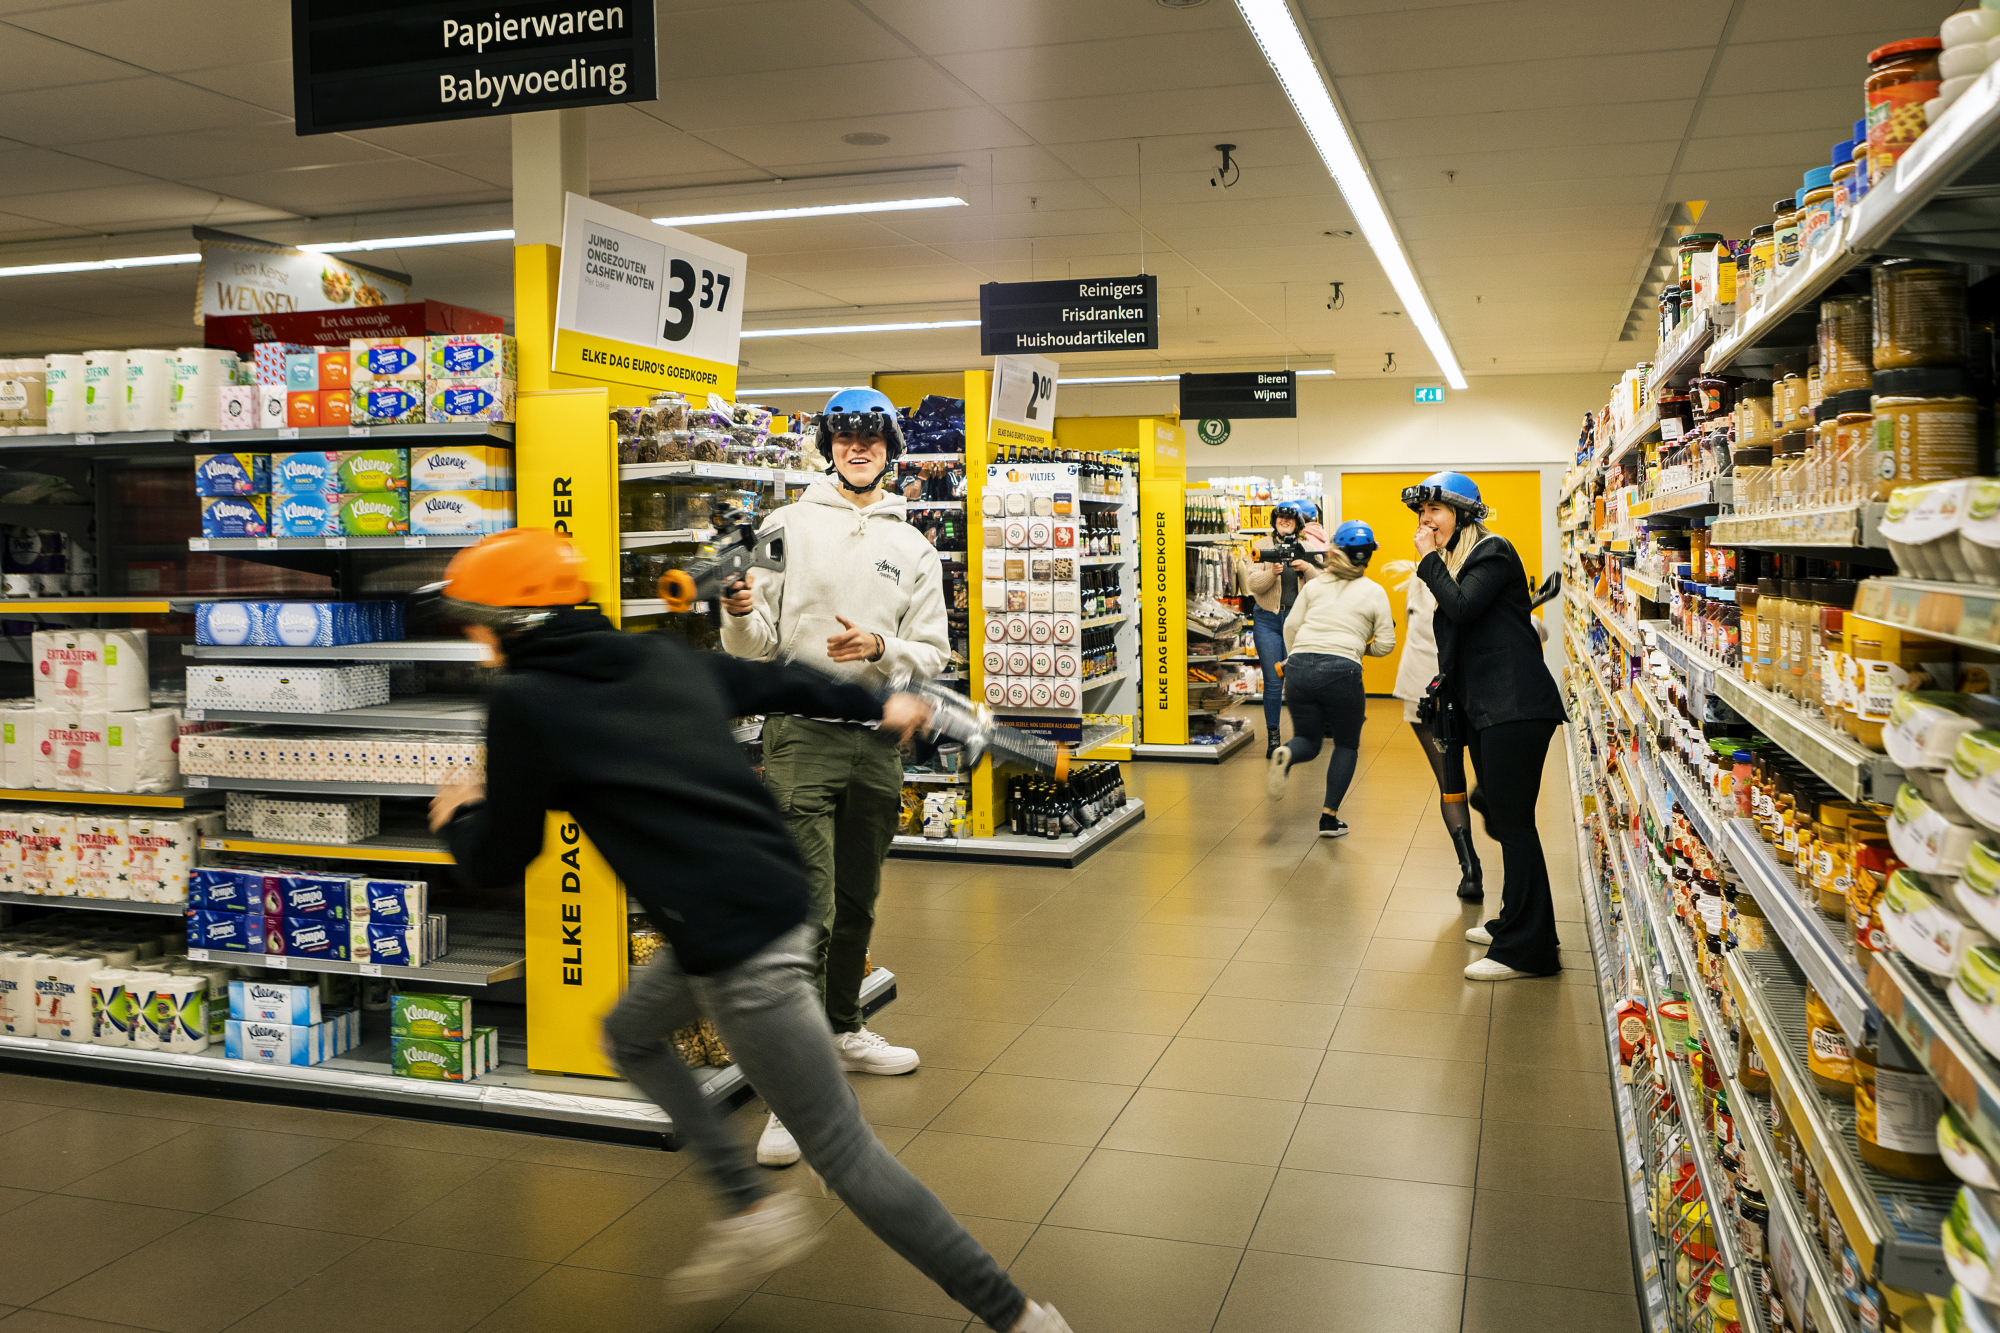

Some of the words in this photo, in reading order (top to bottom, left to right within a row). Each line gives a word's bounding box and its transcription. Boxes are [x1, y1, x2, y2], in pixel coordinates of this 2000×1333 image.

[443, 5, 624, 53] Papierwaren
[439, 59, 628, 106] Babyvoeding
[588, 234, 619, 252] JUMBO
[587, 248, 647, 275] ONGEZOUTEN
[234, 263, 257, 276] Een
[259, 262, 290, 286] Kerst
[586, 262, 625, 283] CASHEW
[626, 275, 655, 291] NOTEN
[217, 282, 299, 314] WENSEN
[663, 258, 697, 342] 3
[699, 269, 731, 313] 37
[1079, 282, 1144, 300] Reinigers
[318, 316, 338, 328] Zet
[340, 316, 354, 326] de
[355, 312, 391, 328] magie
[1062, 306, 1144, 323] Frisdranken
[314, 331, 336, 342] van
[338, 328, 362, 340] kerst
[364, 330, 380, 340] op
[382, 325, 408, 338] tafel
[1016, 330, 1146, 348] Huishoudartikelen
[581, 348, 607, 364] ELKE
[609, 353, 630, 370] DAG
[632, 358, 665, 375] EURO'S
[667, 365, 718, 386] GOEDKOPER
[1040, 376, 1052, 400] 00
[1258, 374, 1288, 384] Bieren
[1026, 371, 1040, 420] 2
[1254, 390, 1288, 402] Wijnen
[1210, 423, 1218, 434] 7
[205, 460, 242, 480] Kleenex
[283, 460, 326, 480] Kleenex
[350, 456, 394, 476] Kleenex
[427, 454, 467, 470] Kleenex
[213, 502, 254, 521] Kleenex
[283, 502, 326, 522] Kleenex
[350, 499, 394, 518] Kleenex
[425, 498, 464, 514] Kleenex
[1010, 530, 1020, 538] 50
[1034, 530, 1044, 538] 50
[1156, 512, 1166, 592] GOEDKOPER
[1158, 596, 1167, 642] EURO'S
[991, 626, 1000, 634] 16
[1059, 626, 1069, 634] 21
[47, 649, 72, 660] EXTRA
[72, 650, 98, 662] STERK
[988, 658, 998, 666] 25
[1014, 658, 1024, 666] 30
[1159, 646, 1168, 676] DAG
[1060, 661, 1070, 669] 50
[1870, 674, 1894, 688] BIO
[990, 688, 1000, 696] 60
[1012, 690, 1022, 698] 65
[1036, 689, 1046, 698] 75
[1060, 690, 1070, 698] 80
[1160, 680, 1168, 710] ELKE
[49, 729, 72, 740] EXTRA
[74, 730, 100, 742] STERK
[560, 823, 580, 894] DAG
[209, 882, 238, 902] Tempo
[288, 885, 327, 910] Tempo
[372, 894, 401, 912] Tempo
[207, 920, 237, 940] Tempo
[291, 925, 330, 950] Tempo
[373, 936, 402, 954] Tempo
[562, 904, 582, 986] ELKE
[55, 982, 76, 994] STERK
[249, 985, 285, 1003] Kleenex
[403, 1004, 448, 1026] Kleenex
[247, 1024, 284, 1042] Kleenex
[1815, 1030, 1846, 1047] PINDA
[403, 1046, 448, 1068] Kleenex
